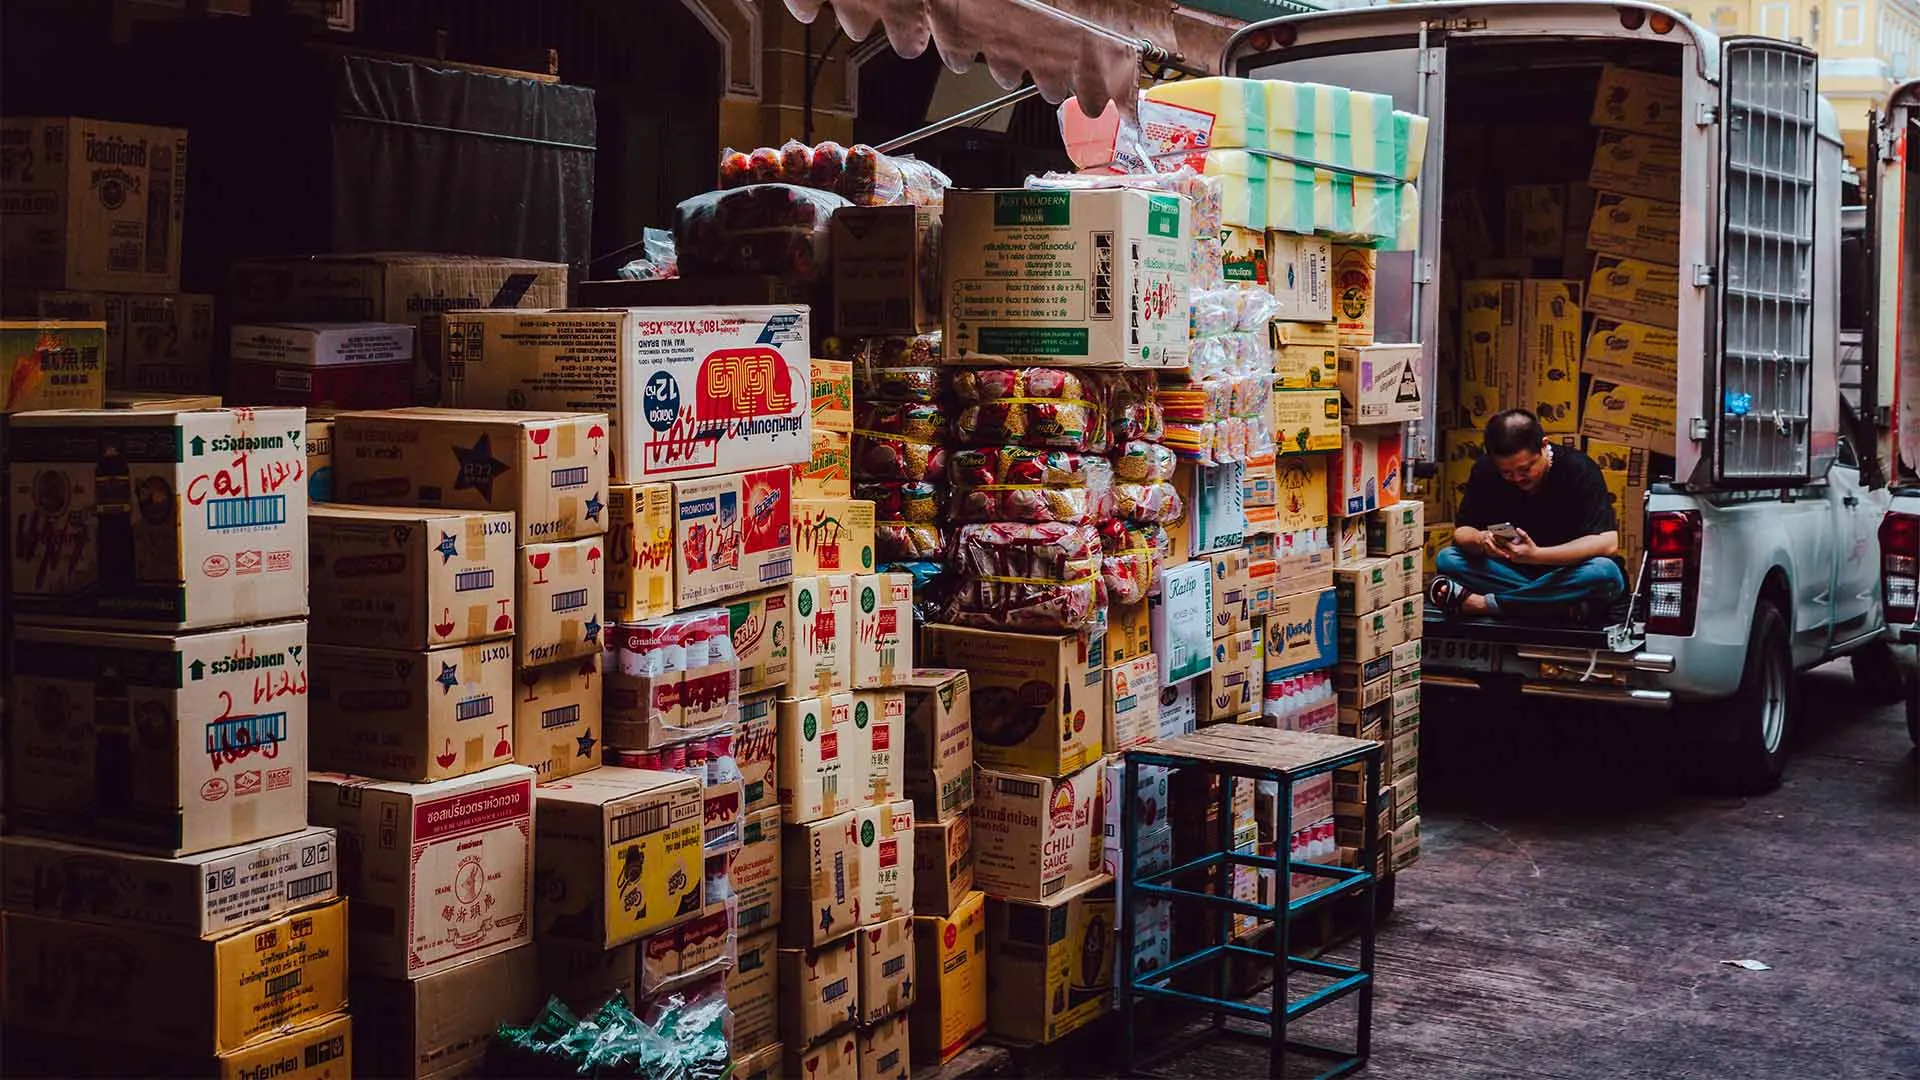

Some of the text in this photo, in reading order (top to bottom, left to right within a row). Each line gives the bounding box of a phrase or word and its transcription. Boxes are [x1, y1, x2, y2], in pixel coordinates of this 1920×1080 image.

[1023, 197, 1066, 206] MODERN
[703, 319, 720, 332] 180
[638, 338, 685, 348] WAI WAI BRAND
[656, 378, 677, 401] 12
[680, 502, 715, 516] PROMOTION
[1044, 834, 1074, 857] CHILI
[1043, 852, 1068, 871] SAUCE
